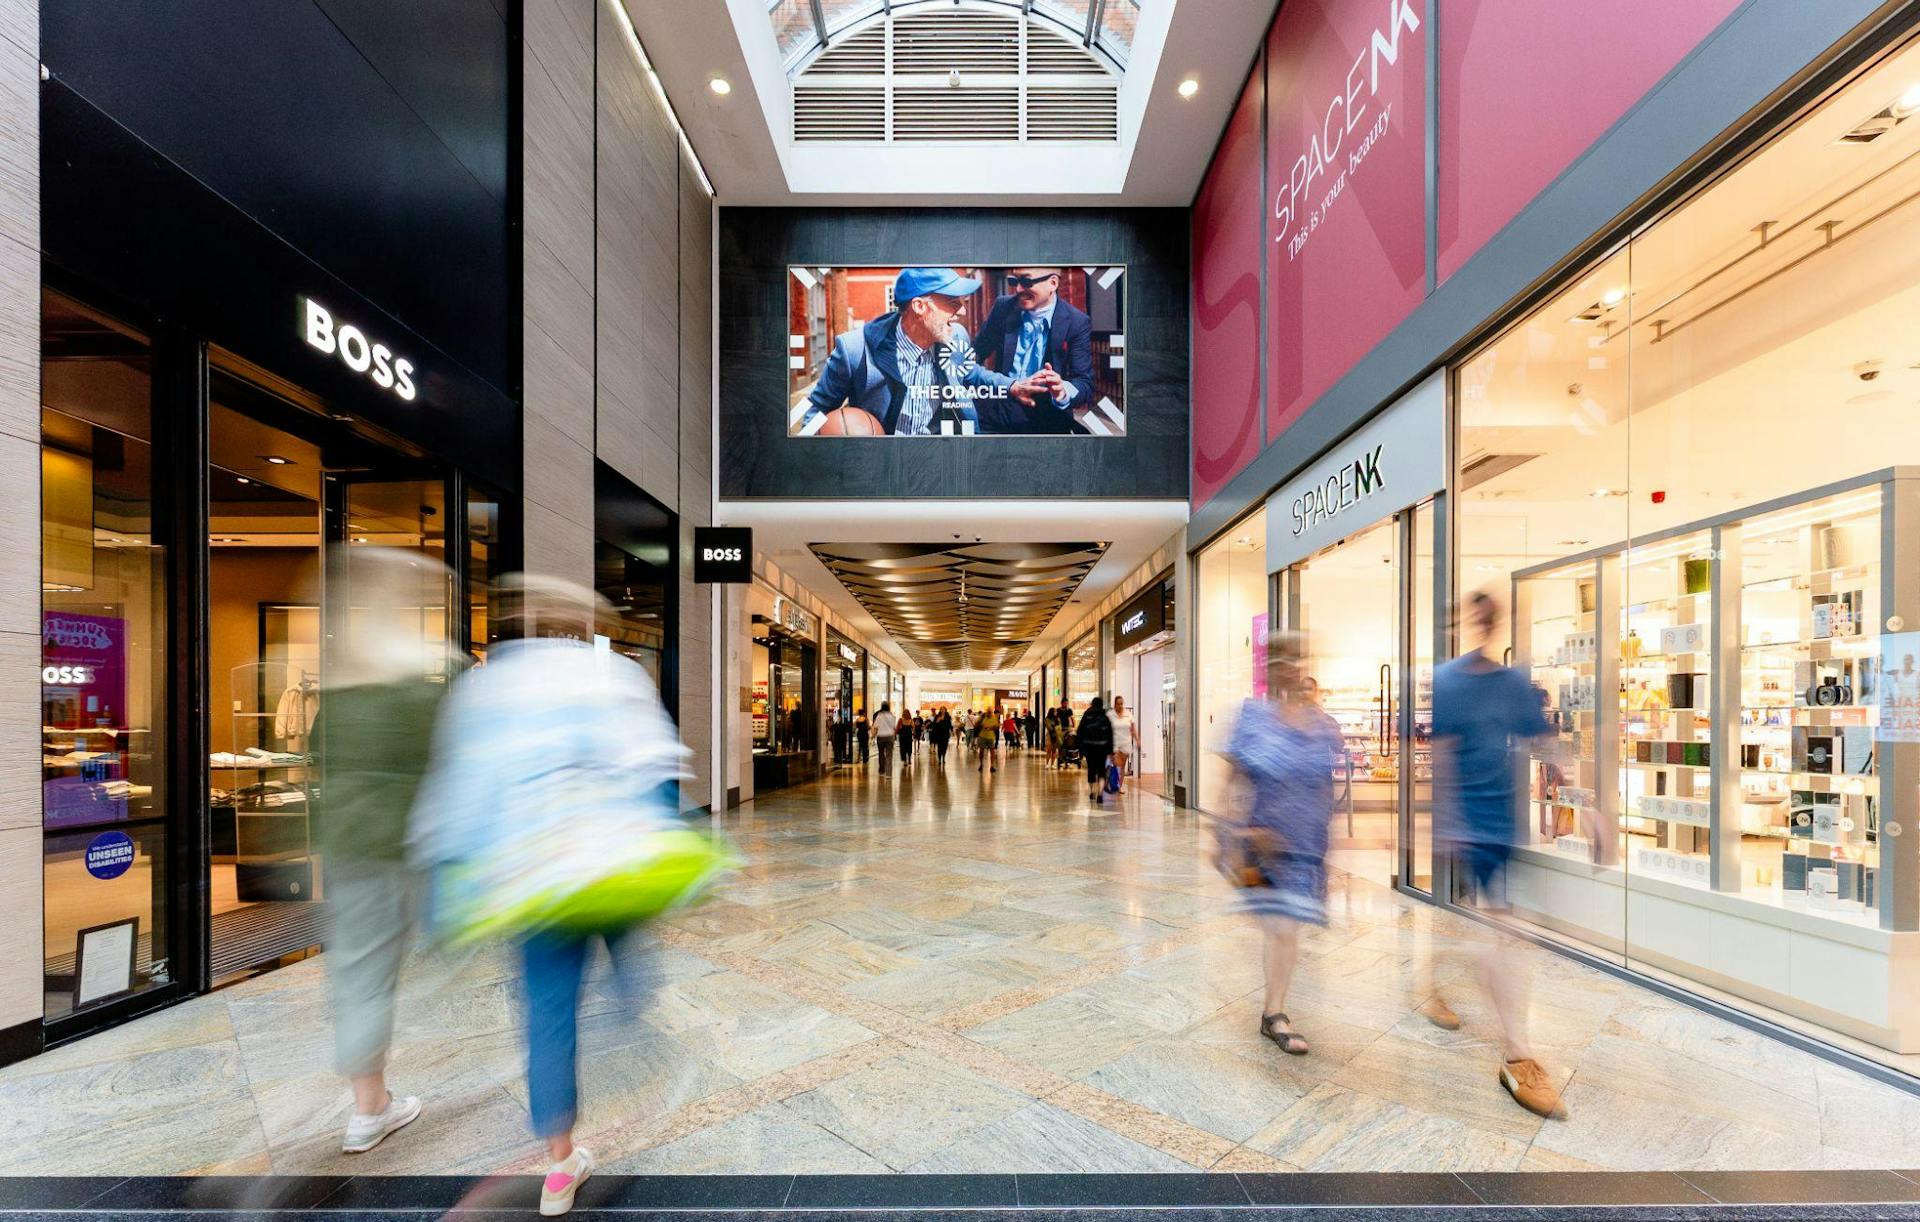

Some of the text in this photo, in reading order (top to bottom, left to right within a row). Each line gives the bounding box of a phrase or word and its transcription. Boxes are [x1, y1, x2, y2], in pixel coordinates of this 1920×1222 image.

[1287, 102, 1393, 263] This is your beauty
[306, 298, 416, 401] BOSS
[908, 385, 1008, 399] THE ORACLE
[942, 401, 974, 409] READING
[703, 548, 742, 562] BOSS
[88, 845, 133, 862] UNSEEN
[88, 855, 133, 869] DISABILITIES
